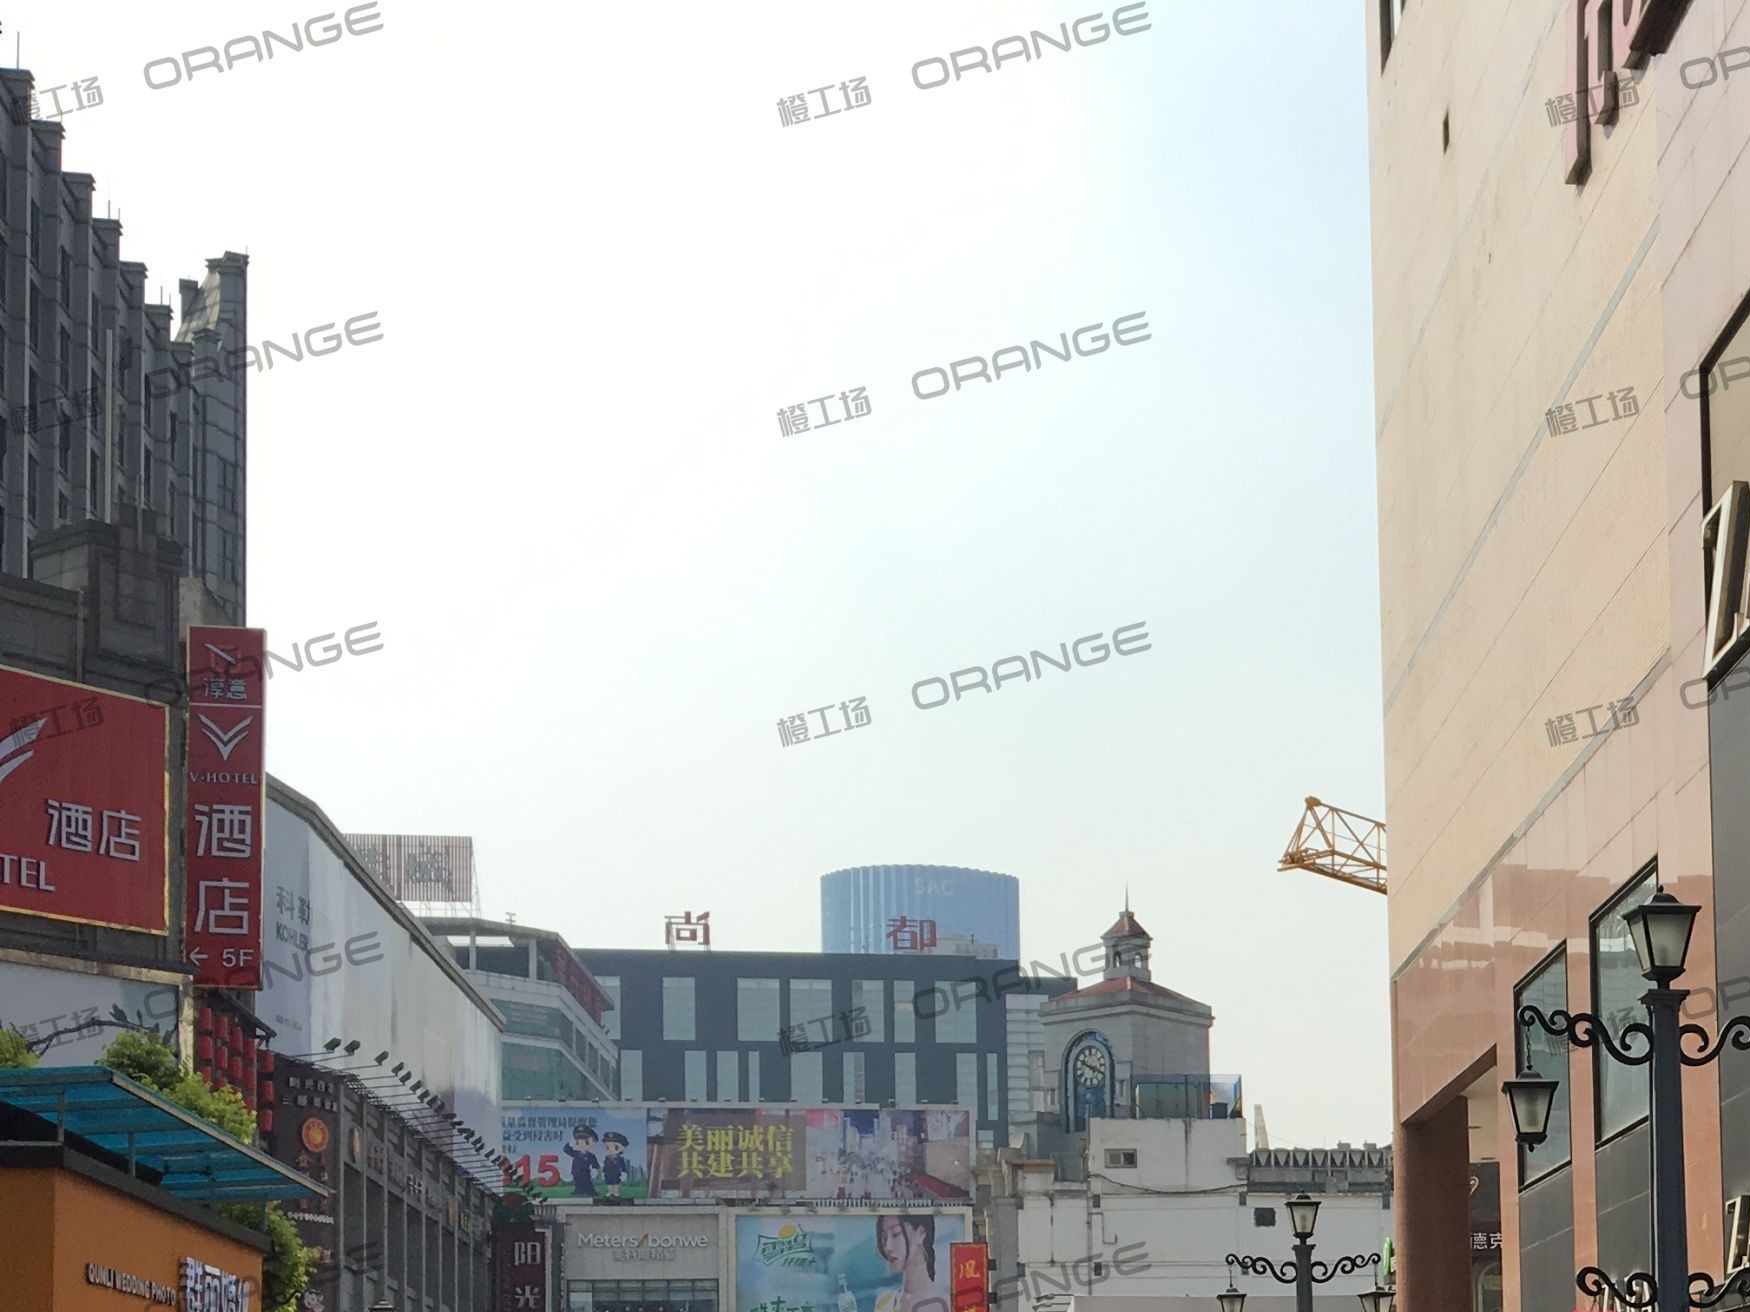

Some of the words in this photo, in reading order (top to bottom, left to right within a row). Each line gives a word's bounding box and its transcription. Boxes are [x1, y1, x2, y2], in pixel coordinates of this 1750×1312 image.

[46, 798, 142, 862] 酒店
[194, 802, 252, 935] 酒店
[913, 876, 954, 897] SAC
[222, 947, 254, 968] 5F
[676, 1123, 795, 1152] 美丽诚信
[676, 1151, 793, 1179] 共建共享
[151, 1280, 177, 1307] PHOTO
